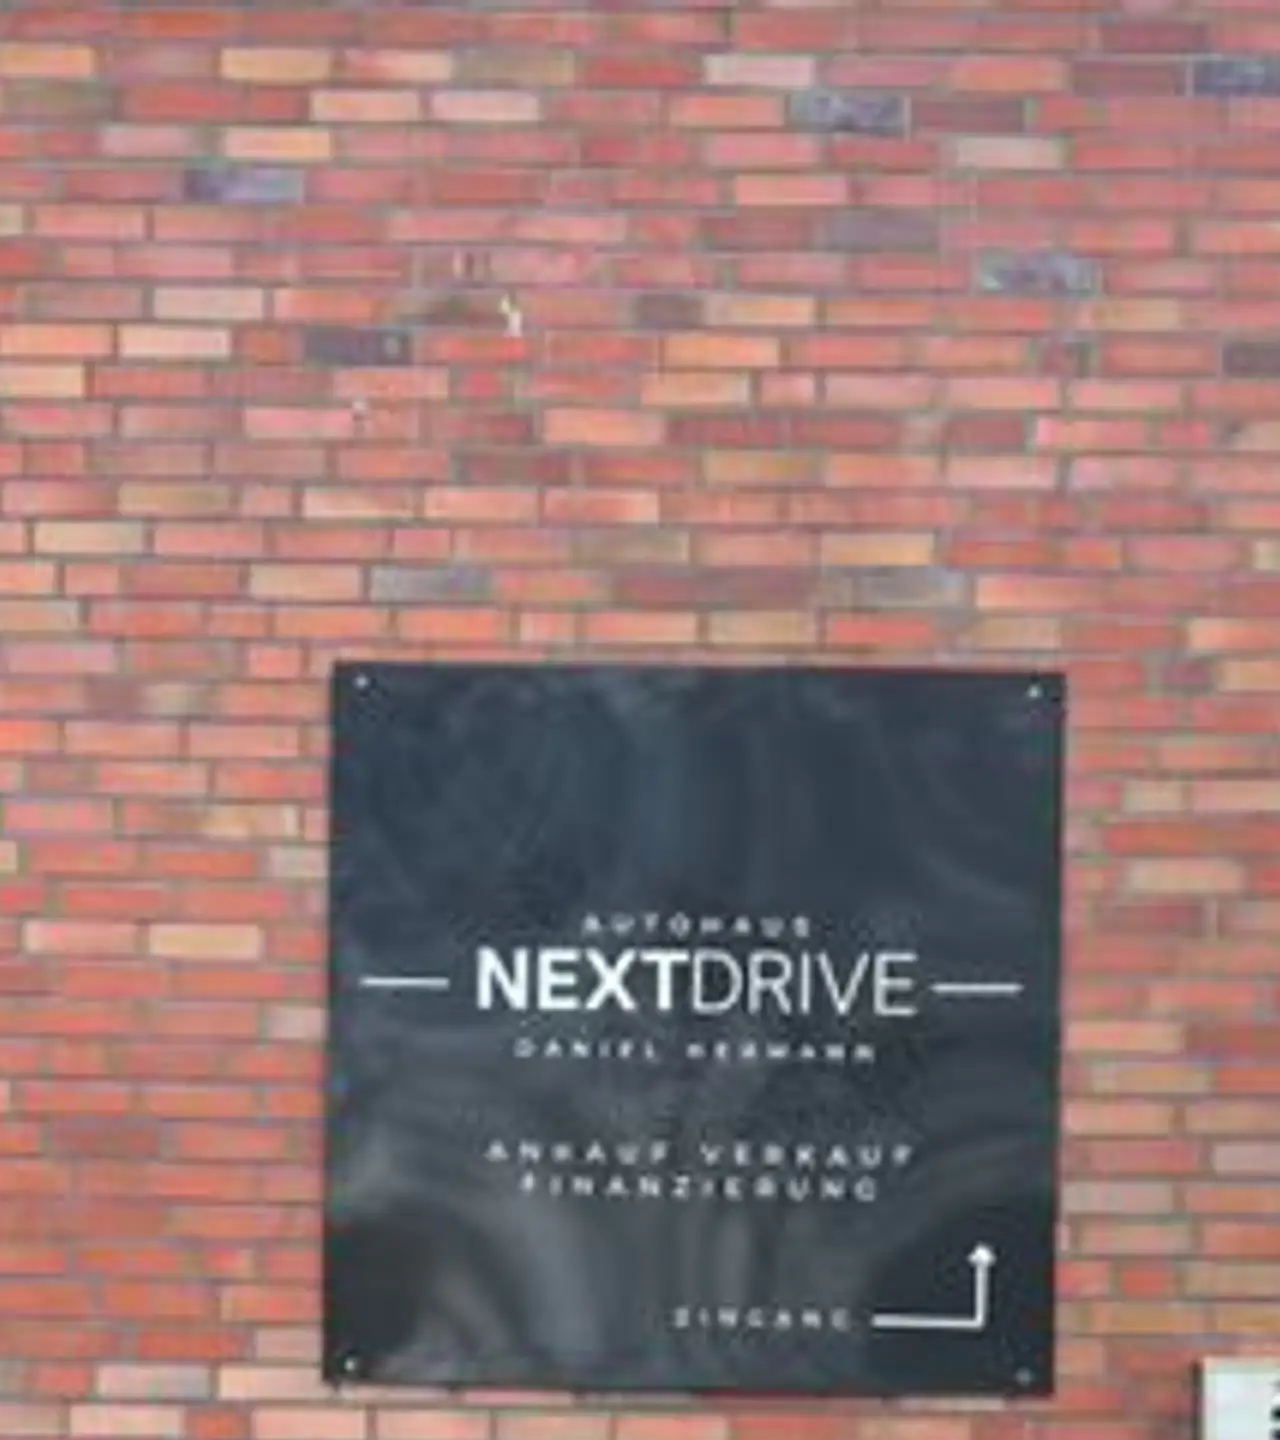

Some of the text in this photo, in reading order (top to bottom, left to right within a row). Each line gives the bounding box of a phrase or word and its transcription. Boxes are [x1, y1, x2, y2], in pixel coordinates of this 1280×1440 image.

[580, 911, 811, 940] AUTOHAUS
[475, 945, 919, 1017] NEXTDRIVE
[483, 1138, 914, 1169] ANKAUF VERKAUF
[519, 1170, 878, 1202] FINANZIERUNG
